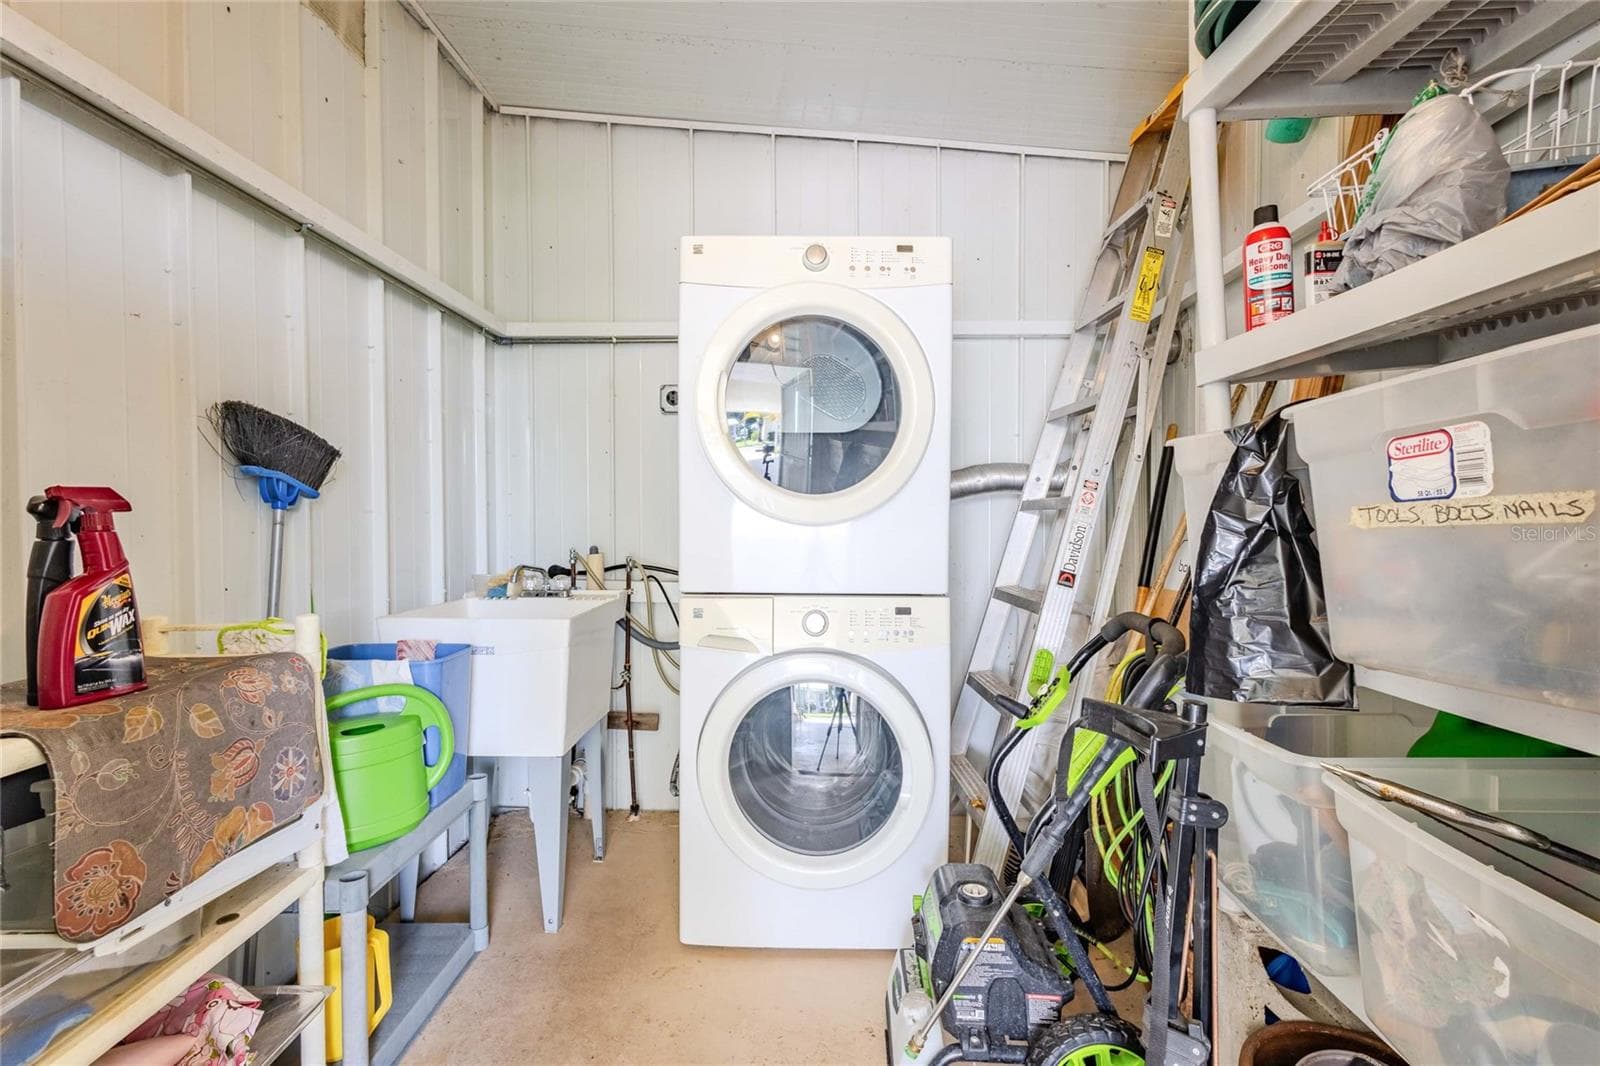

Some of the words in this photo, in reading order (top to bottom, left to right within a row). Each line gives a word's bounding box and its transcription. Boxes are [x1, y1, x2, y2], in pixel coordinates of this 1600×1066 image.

[1258, 241, 1284, 253] CRC
[1248, 256, 1274, 267] Heavy
[1254, 262, 1288, 274] Silicone
[1394, 438, 1442, 456] Sterilite
[1503, 500, 1586, 518] NAILS
[1063, 526, 1086, 572] Davidson
[109, 608, 136, 636] WAX
